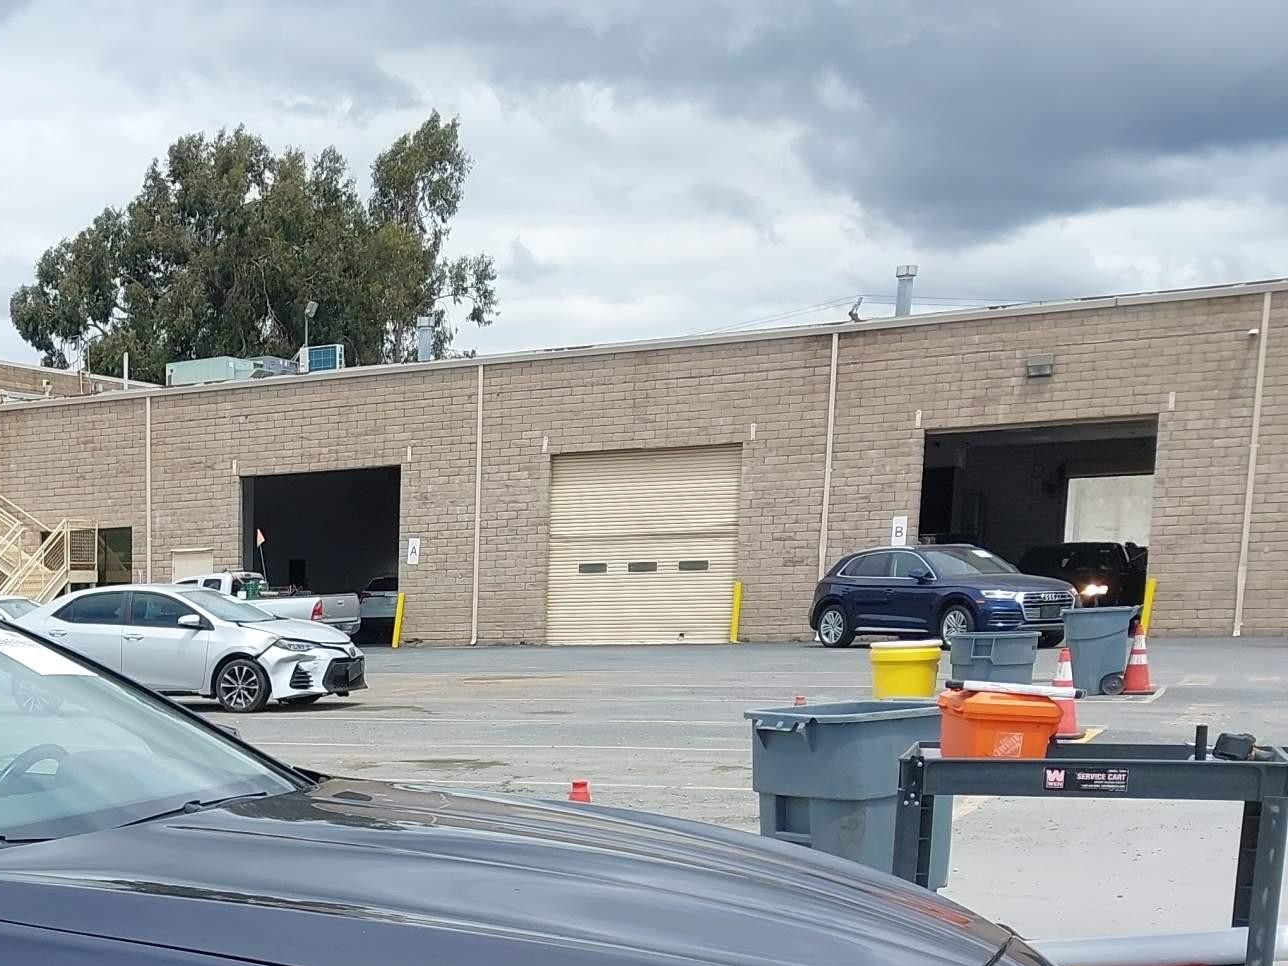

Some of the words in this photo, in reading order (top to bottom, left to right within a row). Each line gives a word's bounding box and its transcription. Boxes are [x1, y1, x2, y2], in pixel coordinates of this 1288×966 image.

[895, 526, 904, 538] B
[409, 545, 417, 556] A
[1077, 773, 1106, 781] SERVICE
[1107, 773, 1127, 781] CART
